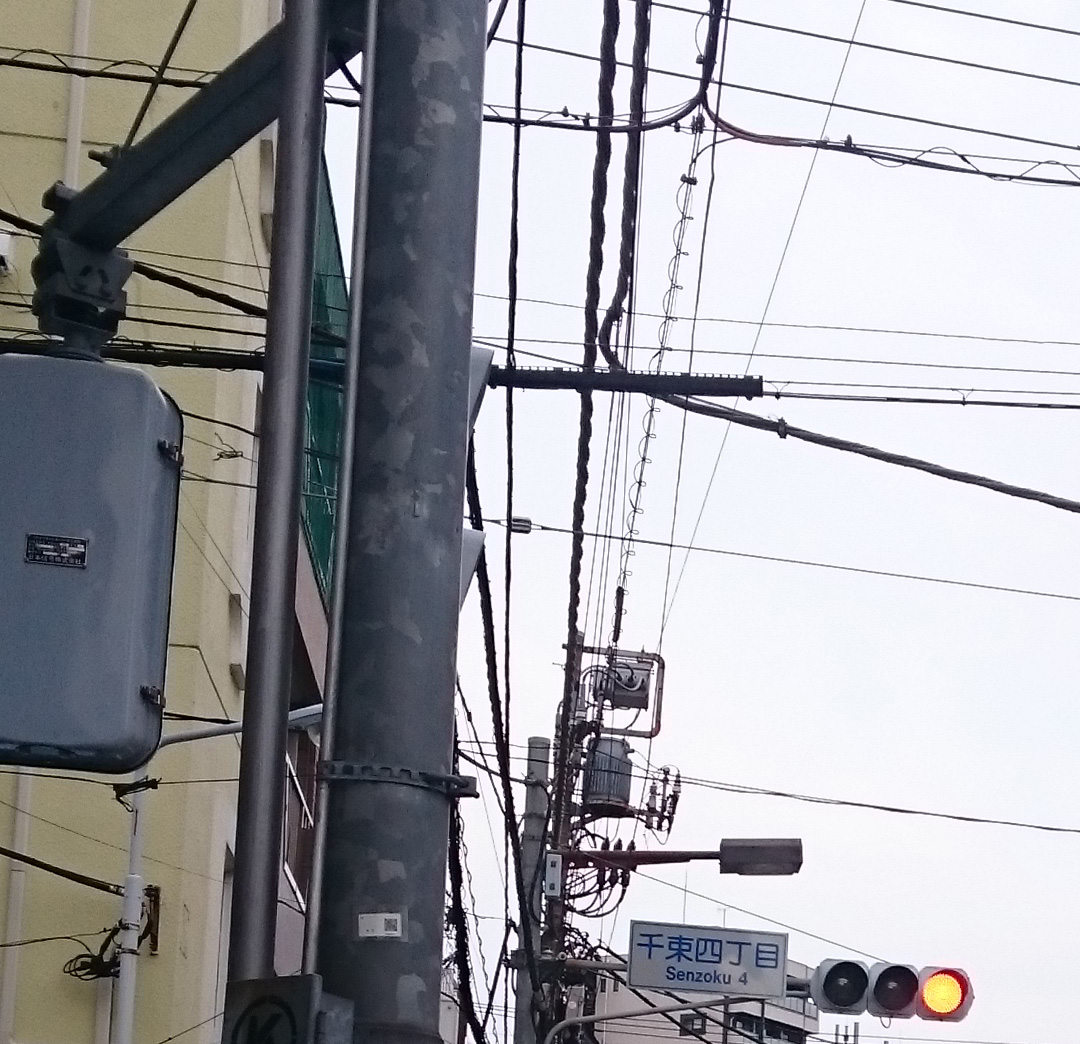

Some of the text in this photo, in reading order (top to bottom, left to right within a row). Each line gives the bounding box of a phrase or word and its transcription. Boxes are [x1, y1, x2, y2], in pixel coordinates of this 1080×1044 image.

[637, 933, 779, 968] 千束四丁目
[665, 966, 749, 986] Senzoku 4
